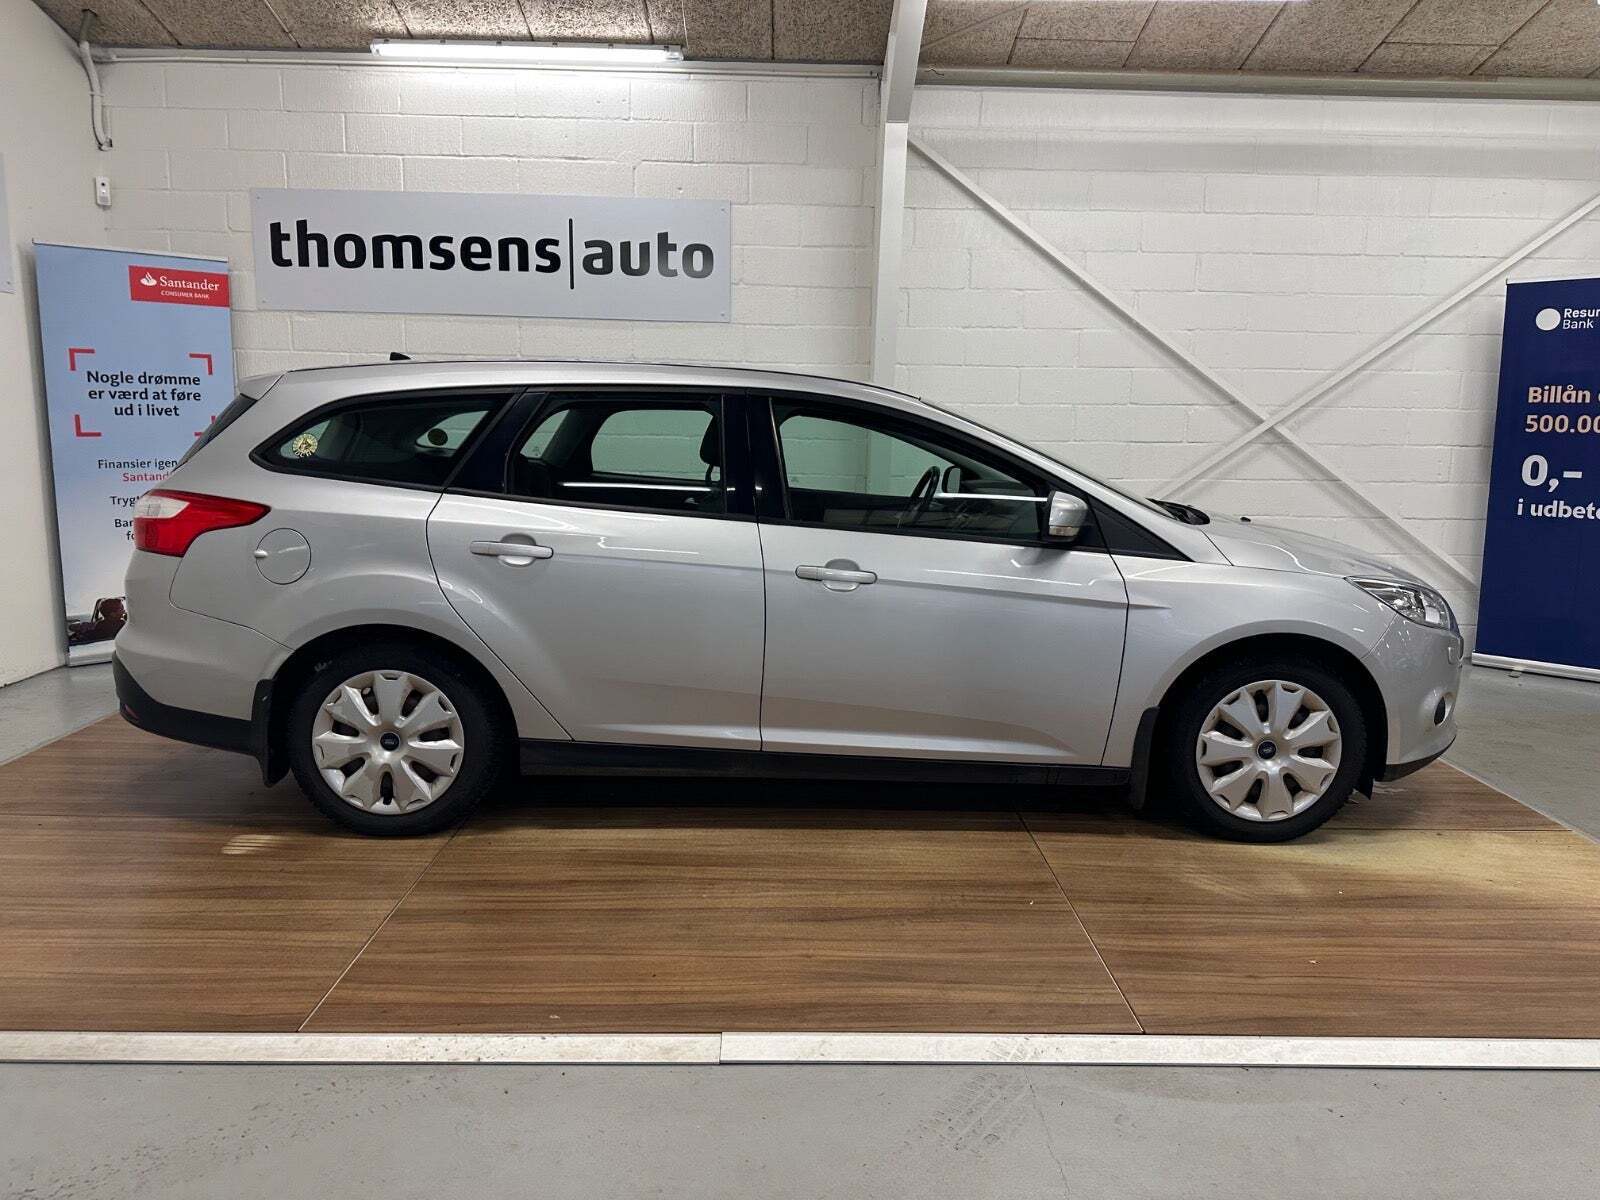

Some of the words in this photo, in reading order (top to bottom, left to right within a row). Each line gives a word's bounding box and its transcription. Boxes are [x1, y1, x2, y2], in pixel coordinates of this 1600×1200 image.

[159, 275, 220, 291] Santander
[160, 290, 193, 298] CONSUMER
[194, 292, 210, 300] BANK
[1562, 318, 1594, 330] Bank
[86, 370, 134, 387] Nogle
[137, 371, 201, 386] drømme
[88, 389, 105, 400] er
[108, 388, 149, 401] værd
[152, 390, 167, 401] at
[170, 388, 202, 402] føre
[1527, 384, 1591, 403] Billån
[114, 403, 134, 416] ud
[138, 403, 142, 416] i
[146, 403, 180, 417] livet
[97, 459, 152, 470] Finansier
[109, 495, 140, 507] Tryg
[1517, 498, 1524, 516] i
